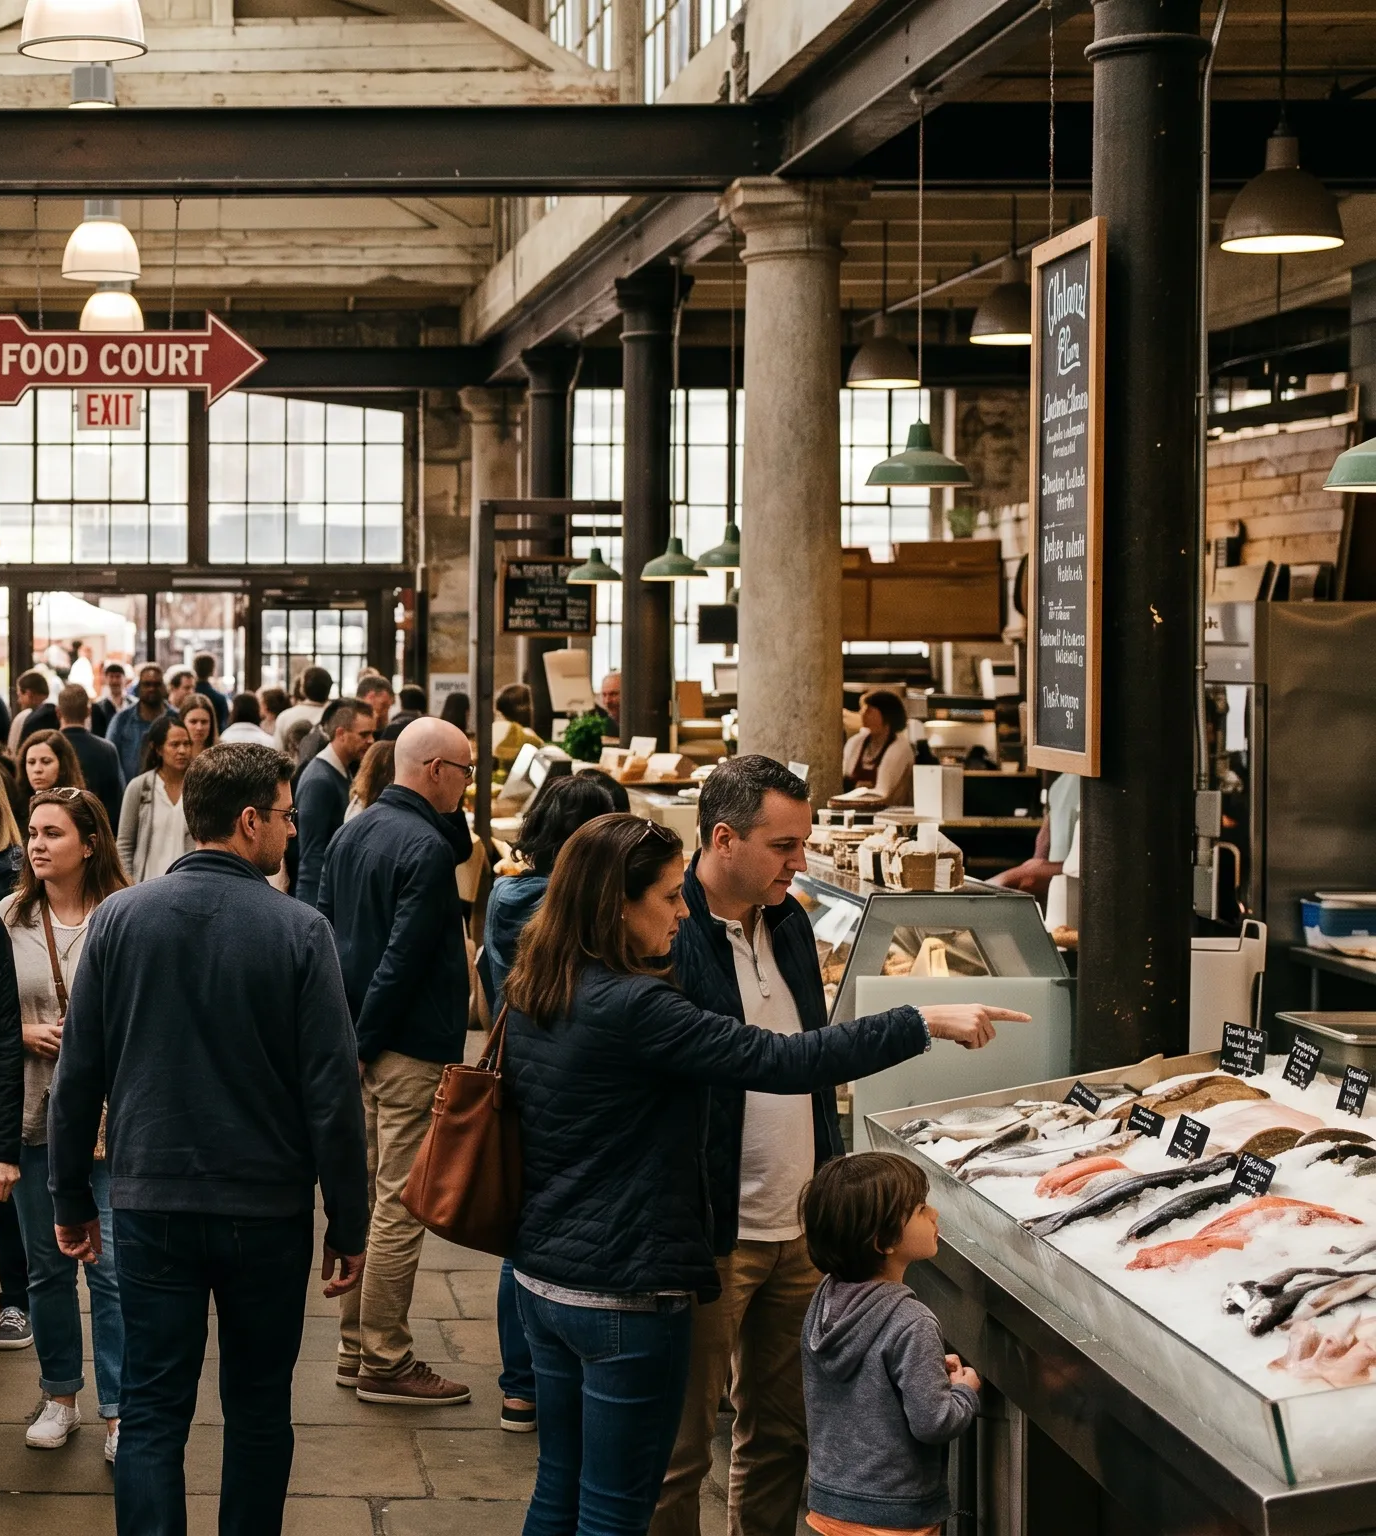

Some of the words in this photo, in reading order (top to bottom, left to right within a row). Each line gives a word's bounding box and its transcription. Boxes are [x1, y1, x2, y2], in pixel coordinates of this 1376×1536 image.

[2, 343, 88, 376] FOOD
[99, 343, 210, 376] COURT
[86, 394, 134, 426] EXIT
